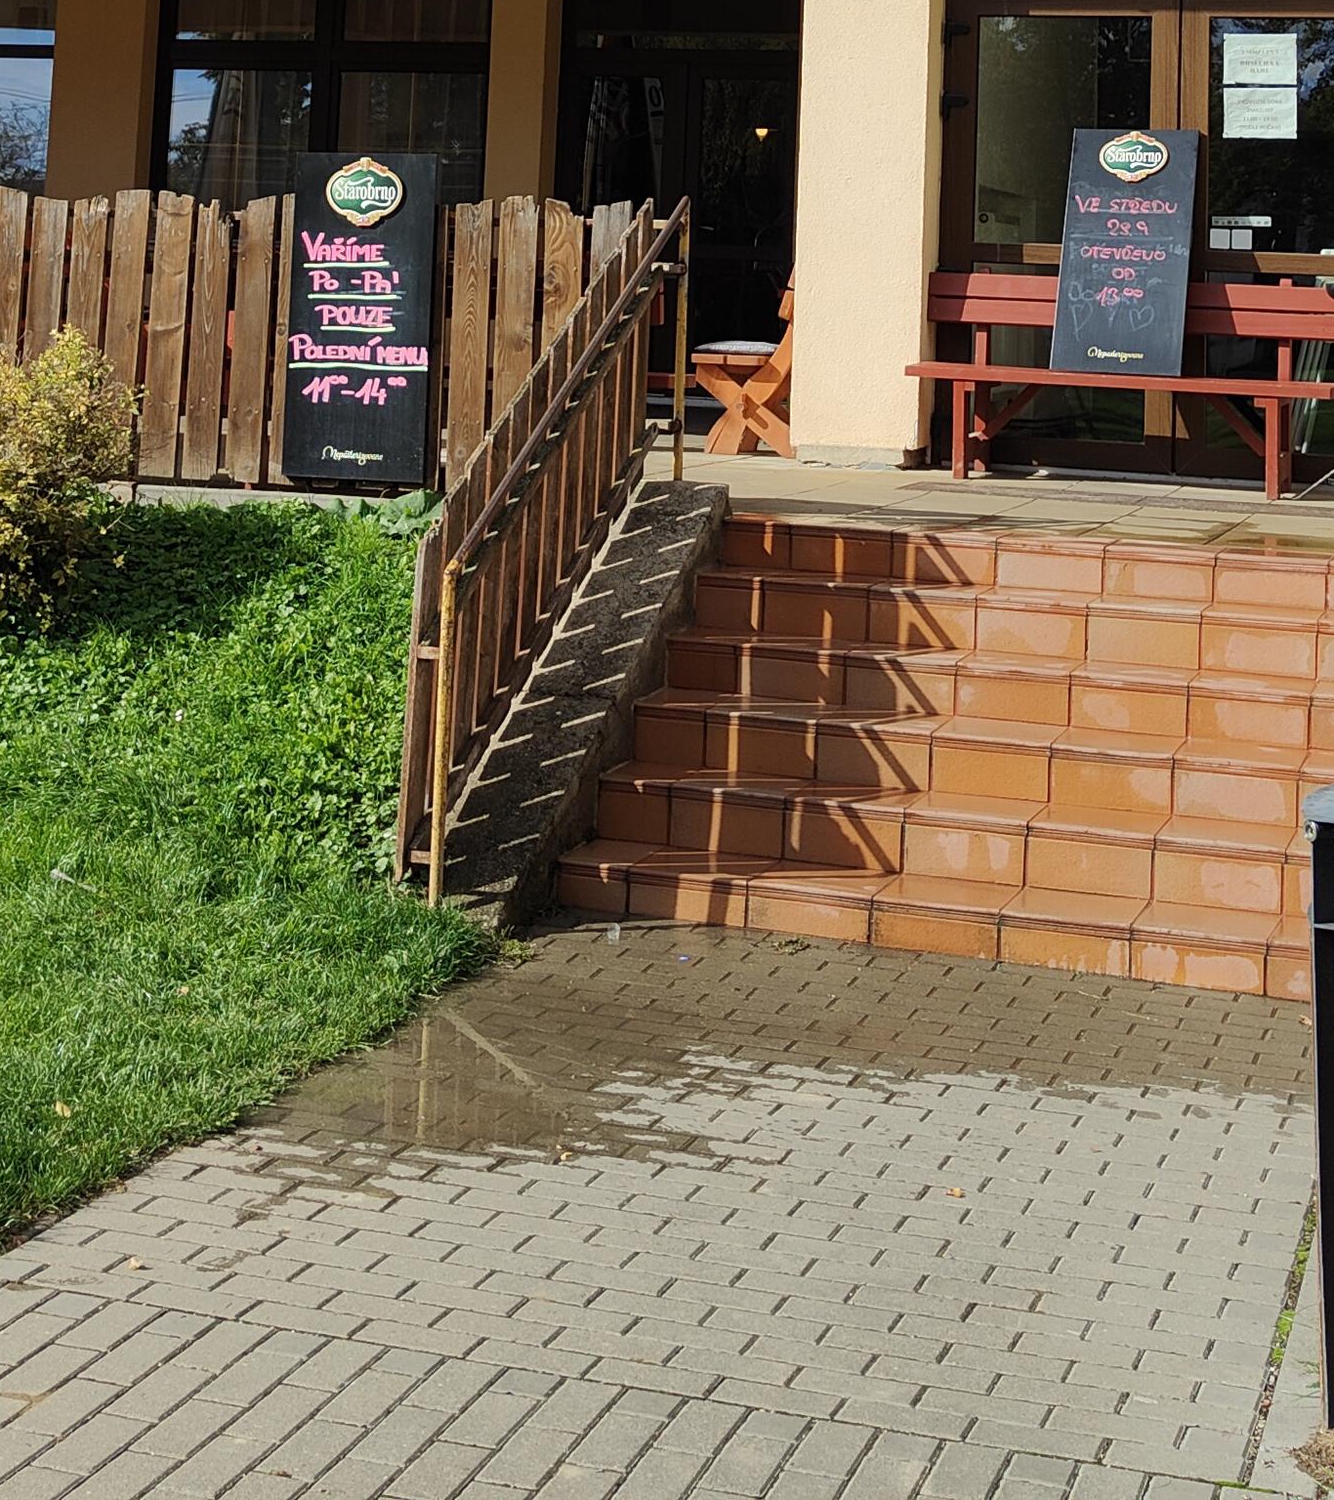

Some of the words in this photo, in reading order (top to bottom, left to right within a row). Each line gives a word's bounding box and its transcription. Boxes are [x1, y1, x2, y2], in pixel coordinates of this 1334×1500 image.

[1107, 145, 1162, 169] Starobrno
[335, 176, 396, 210] Starobrno
[1075, 195, 1101, 213] VE
[301, 230, 384, 261] VAŘÍME
[1111, 267, 1135, 280] OD
[314, 305, 393, 327] POUZE
[288, 334, 383, 360] POLEDNÍ
[376, 347, 428, 366] MENU
